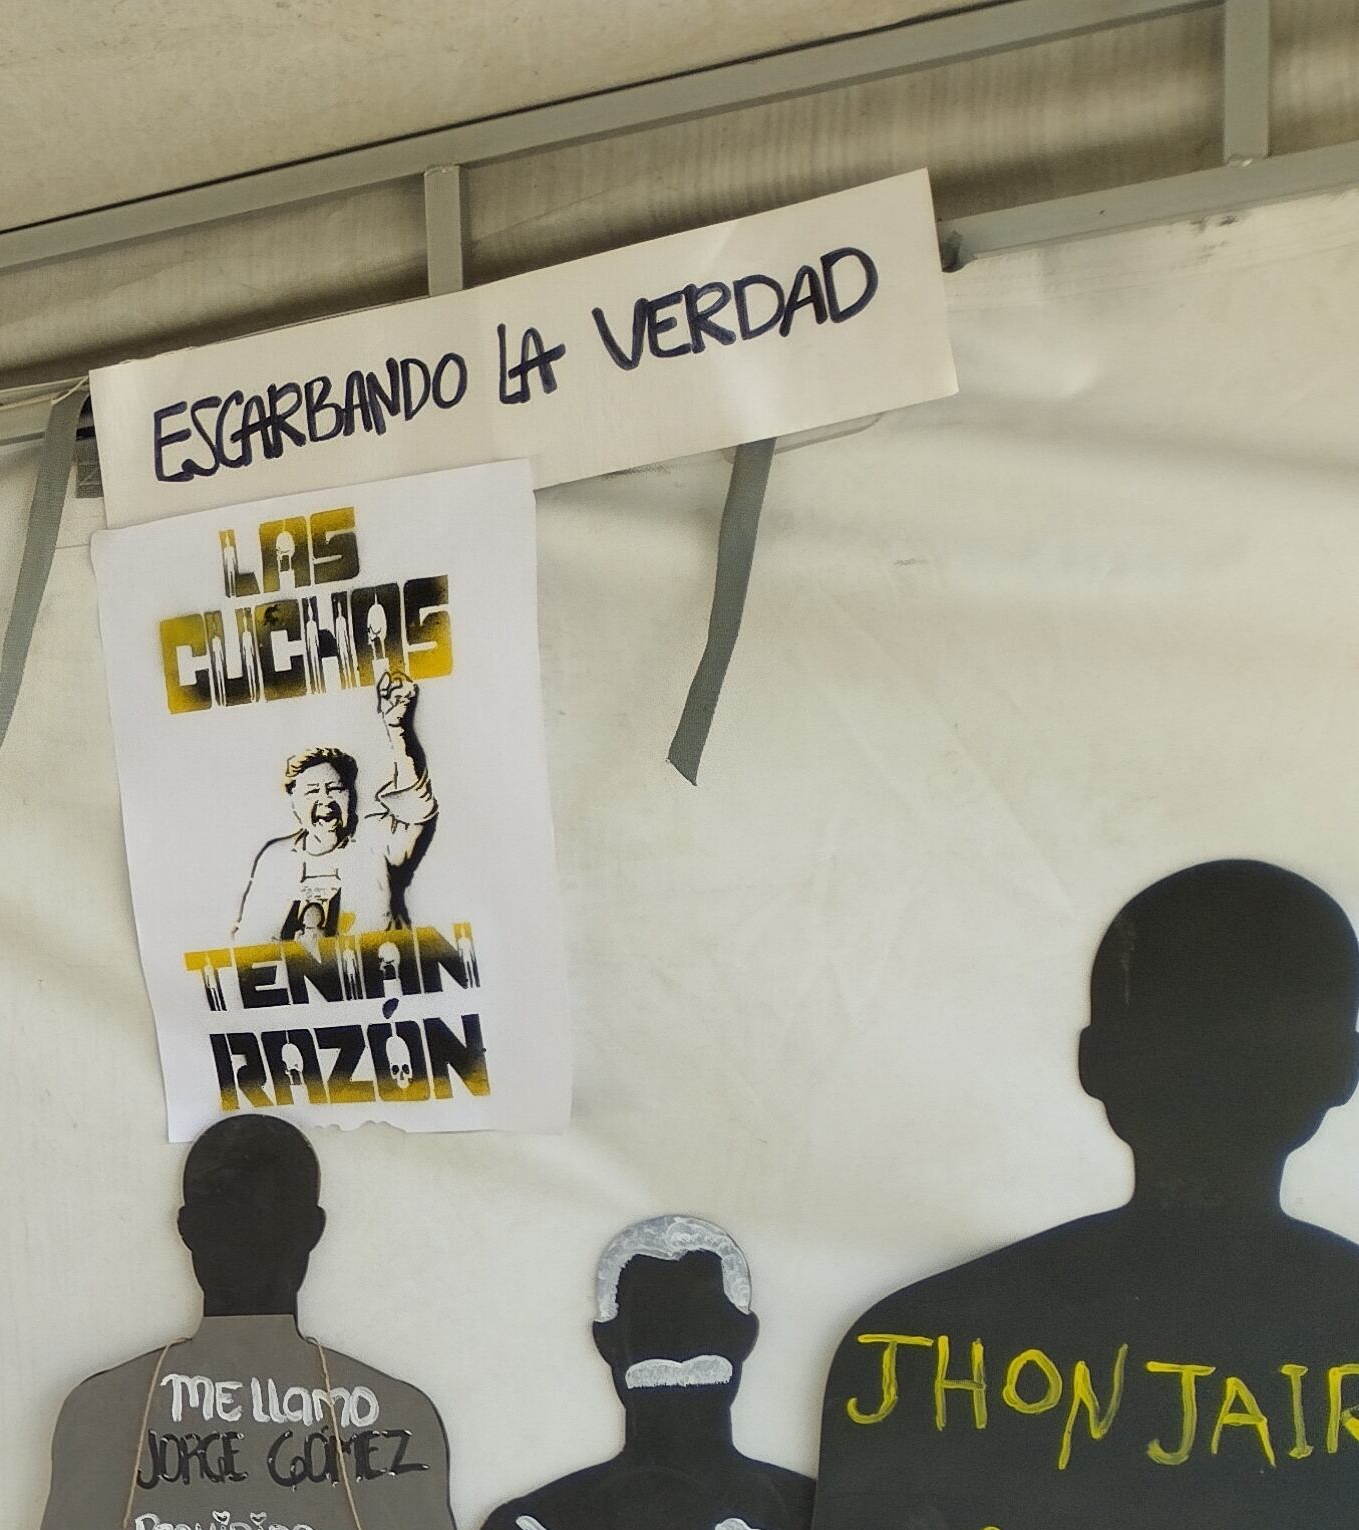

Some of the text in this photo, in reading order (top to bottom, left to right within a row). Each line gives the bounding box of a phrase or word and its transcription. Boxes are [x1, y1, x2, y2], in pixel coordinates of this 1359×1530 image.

[153, 246, 879, 483] ESCARBANDO LA VERDAD
[219, 506, 361, 598] LAS
[159, 575, 454, 714] CUCHAS
[209, 997, 491, 1112] RAZÓN
[159, 1373, 244, 1423] ME
[845, 1333, 1128, 1470] JHON
